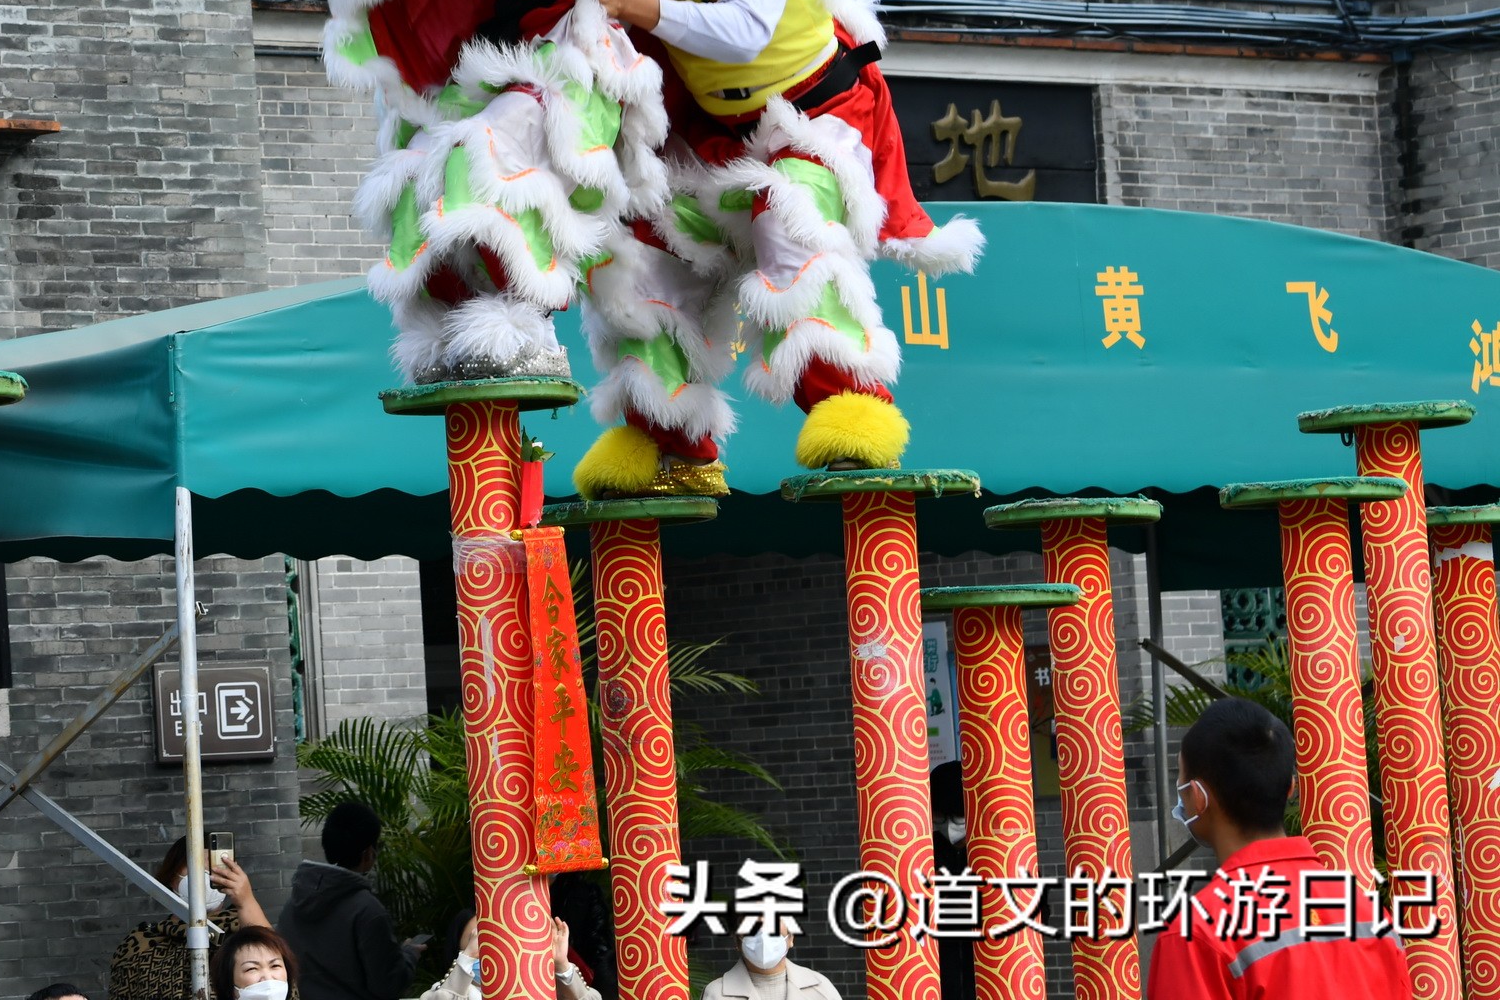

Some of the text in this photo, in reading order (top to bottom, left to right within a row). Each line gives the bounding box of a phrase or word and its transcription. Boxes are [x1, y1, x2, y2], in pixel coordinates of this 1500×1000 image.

[931, 99, 1036, 201] 地
[541, 572, 580, 794] 合家平安
